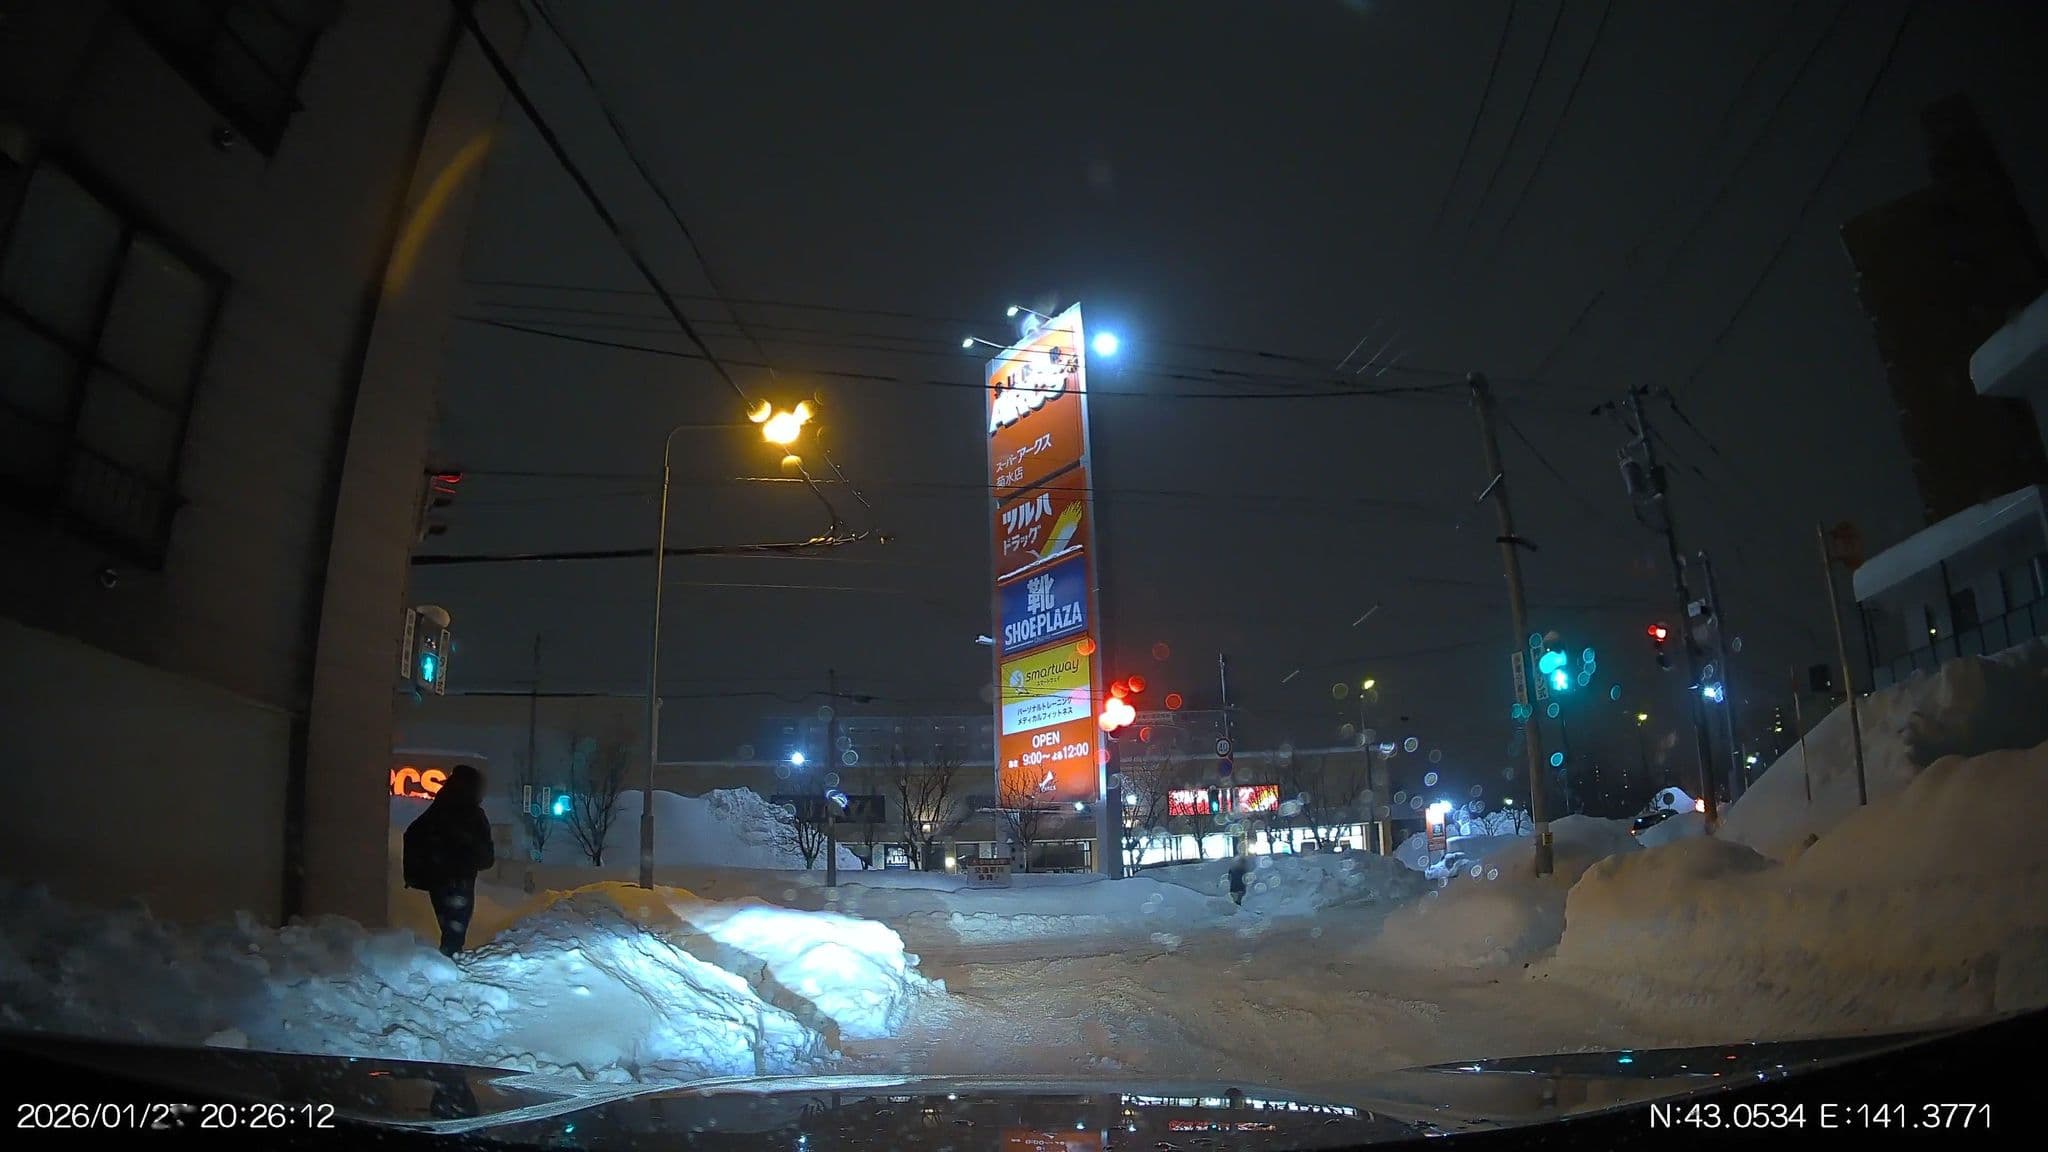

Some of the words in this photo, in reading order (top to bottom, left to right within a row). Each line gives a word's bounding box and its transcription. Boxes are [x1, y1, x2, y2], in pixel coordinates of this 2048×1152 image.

[996, 433, 1052, 473] スーパーアークス
[996, 466, 1024, 490] 菊水店
[1002, 492, 1053, 535] ツルハ
[1003, 525, 1042, 556] ドラッグ
[1026, 573, 1055, 615] 靴
[1025, 658, 1080, 683] smartway
[1032, 730, 1060, 749] OPEN
[390, 767, 448, 800] CS
